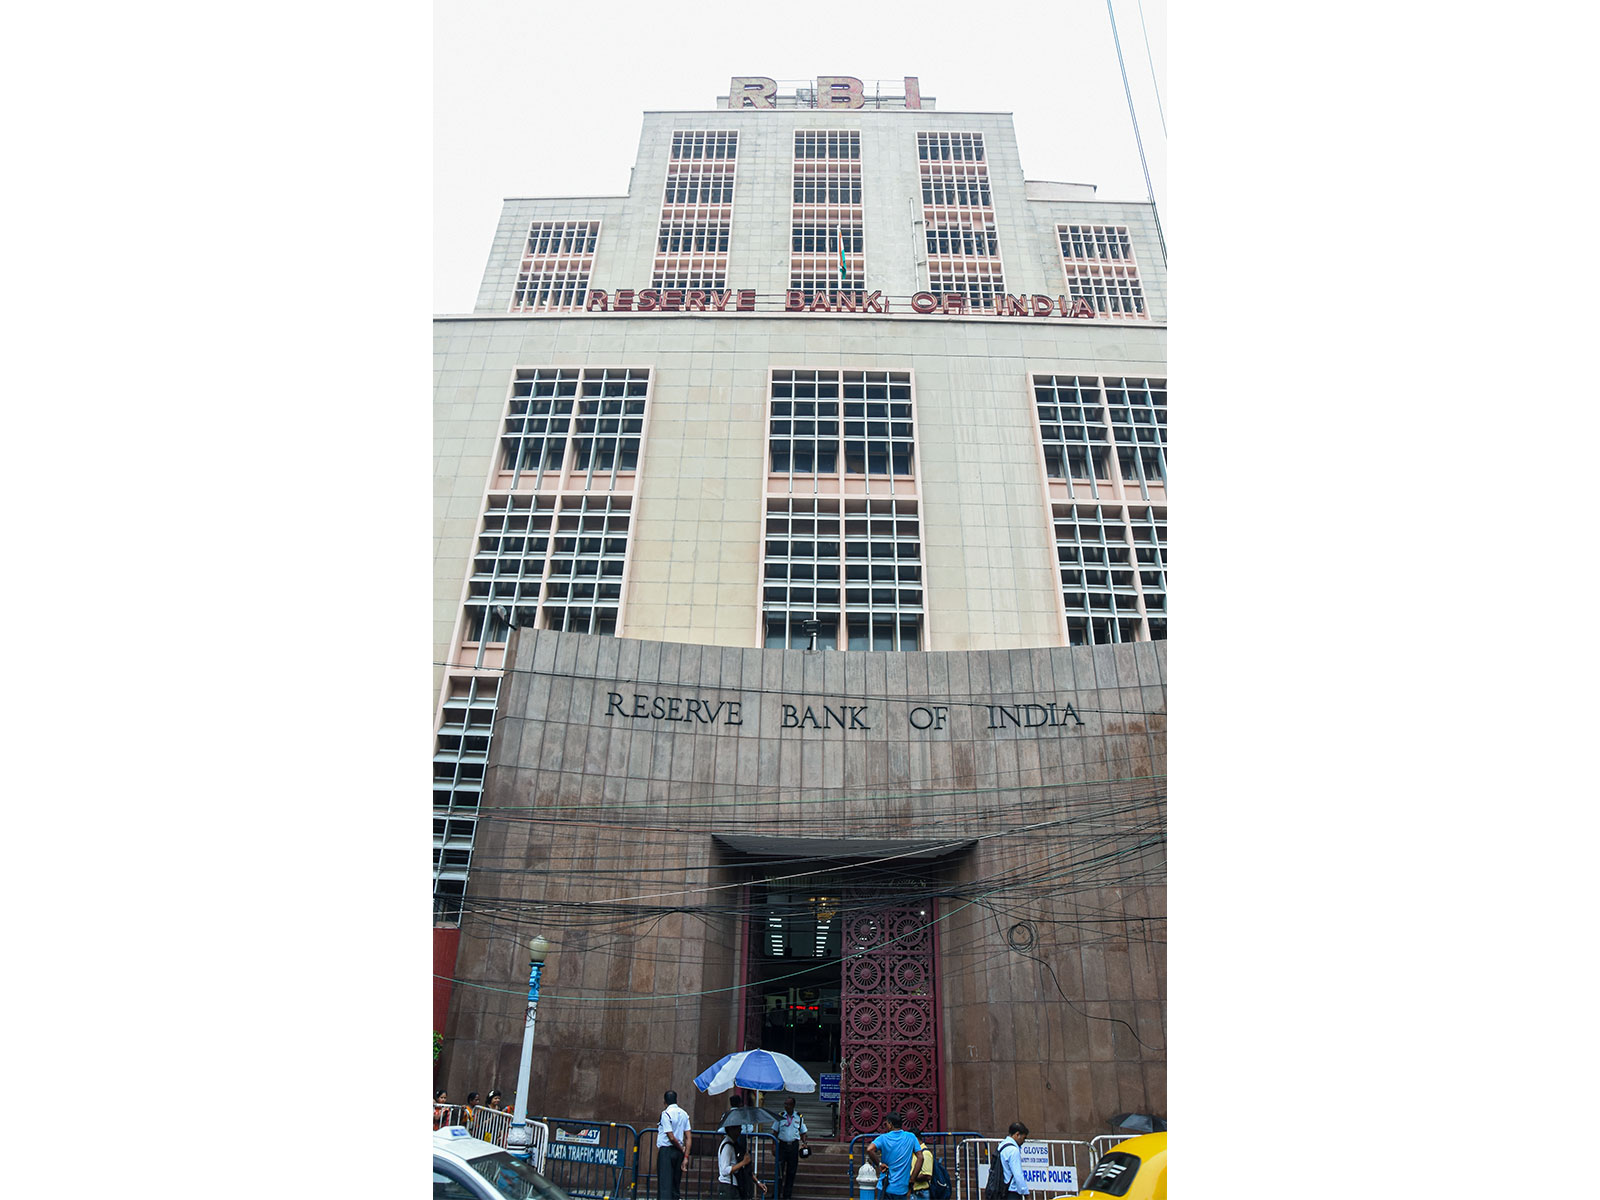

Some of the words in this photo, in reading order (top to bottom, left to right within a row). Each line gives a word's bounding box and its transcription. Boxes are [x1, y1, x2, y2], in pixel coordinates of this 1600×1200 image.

[728, 76, 921, 109] RBI
[587, 288, 756, 312] RESERVE
[785, 289, 882, 313] BANK
[911, 291, 963, 314] OF
[995, 293, 1095, 318] INDIA
[605, 692, 743, 726] RESERVE
[781, 704, 871, 730] BANK
[909, 707, 948, 730] OF
[986, 702, 1085, 729] INDIA
[547, 1143, 567, 1159] LKATA
[568, 1146, 594, 1162] TRAFFIC
[595, 1149, 618, 1165] POLICE
[1023, 1146, 1048, 1154] GLOVES
[1022, 1169, 1047, 1182] RAFFIC
[1048, 1170, 1072, 1183] POLICE
